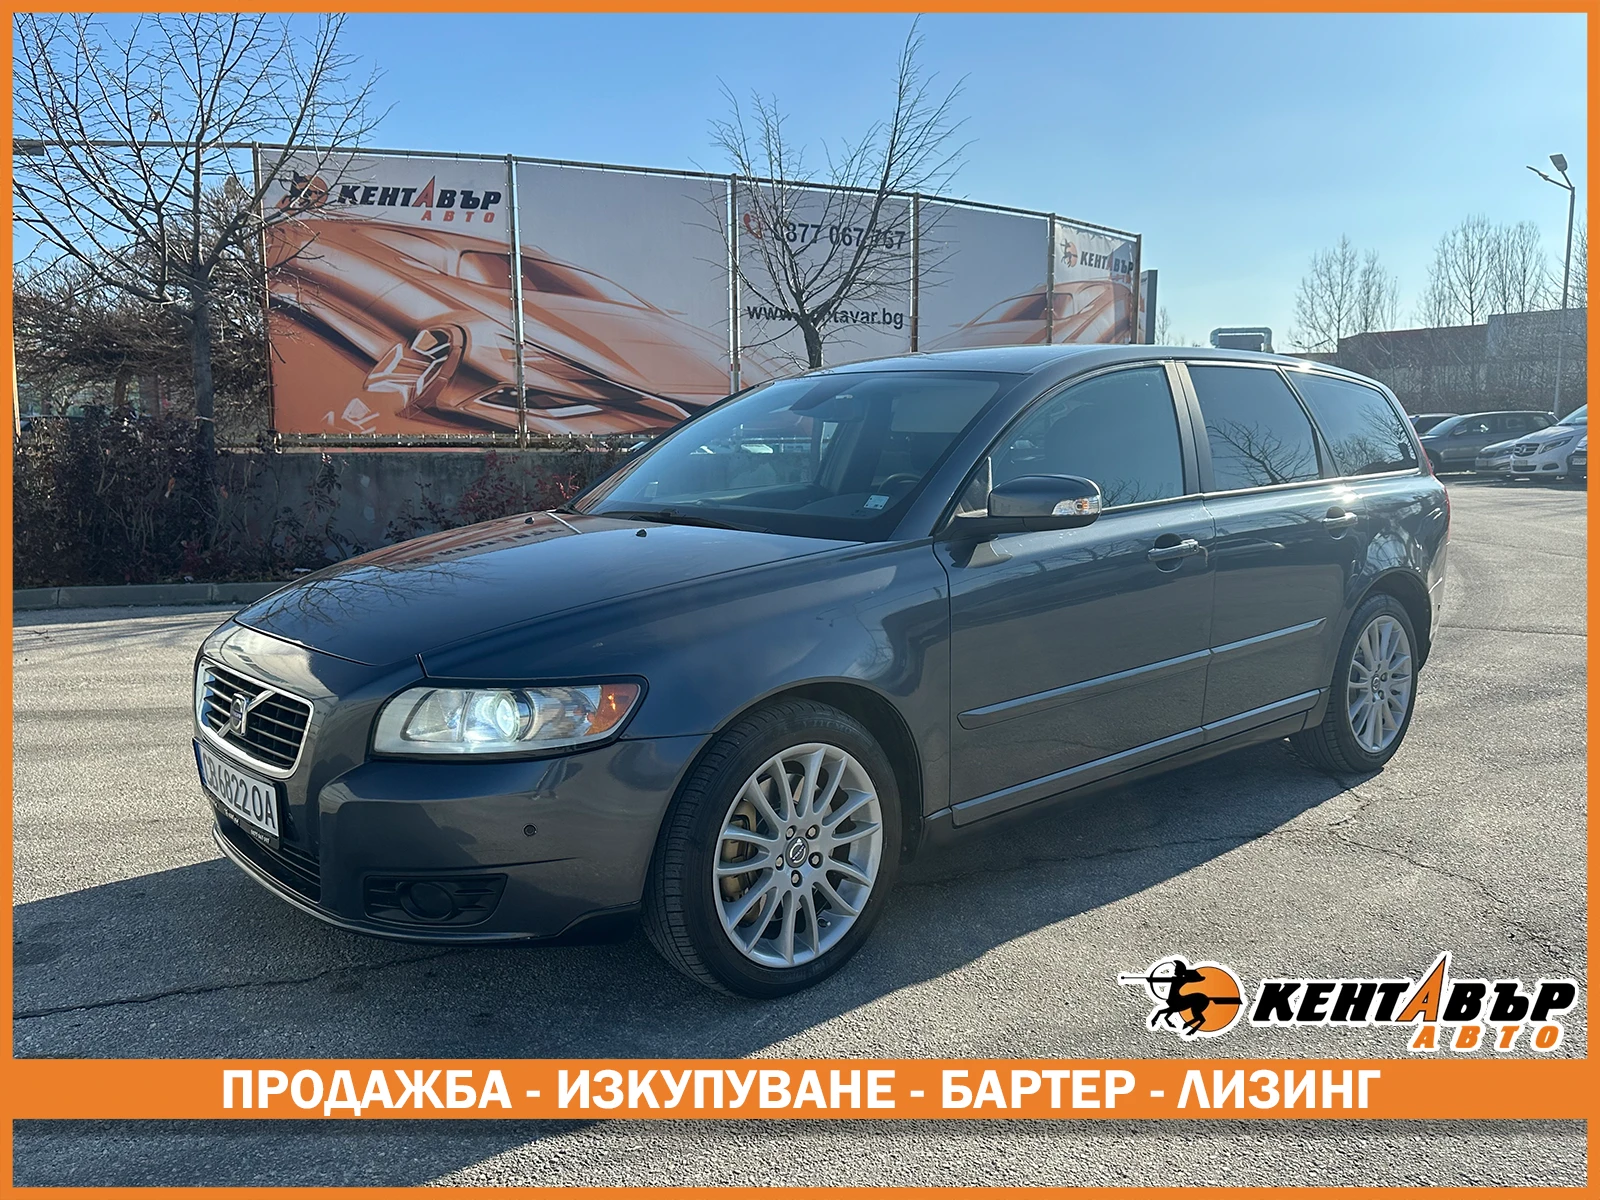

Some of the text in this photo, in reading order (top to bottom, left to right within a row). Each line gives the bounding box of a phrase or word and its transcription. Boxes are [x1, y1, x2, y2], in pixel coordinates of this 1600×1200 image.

[338, 175, 502, 210] КЕНТАВЪР
[421, 210, 495, 224] АВТО
[829, 225, 864, 247] 067
